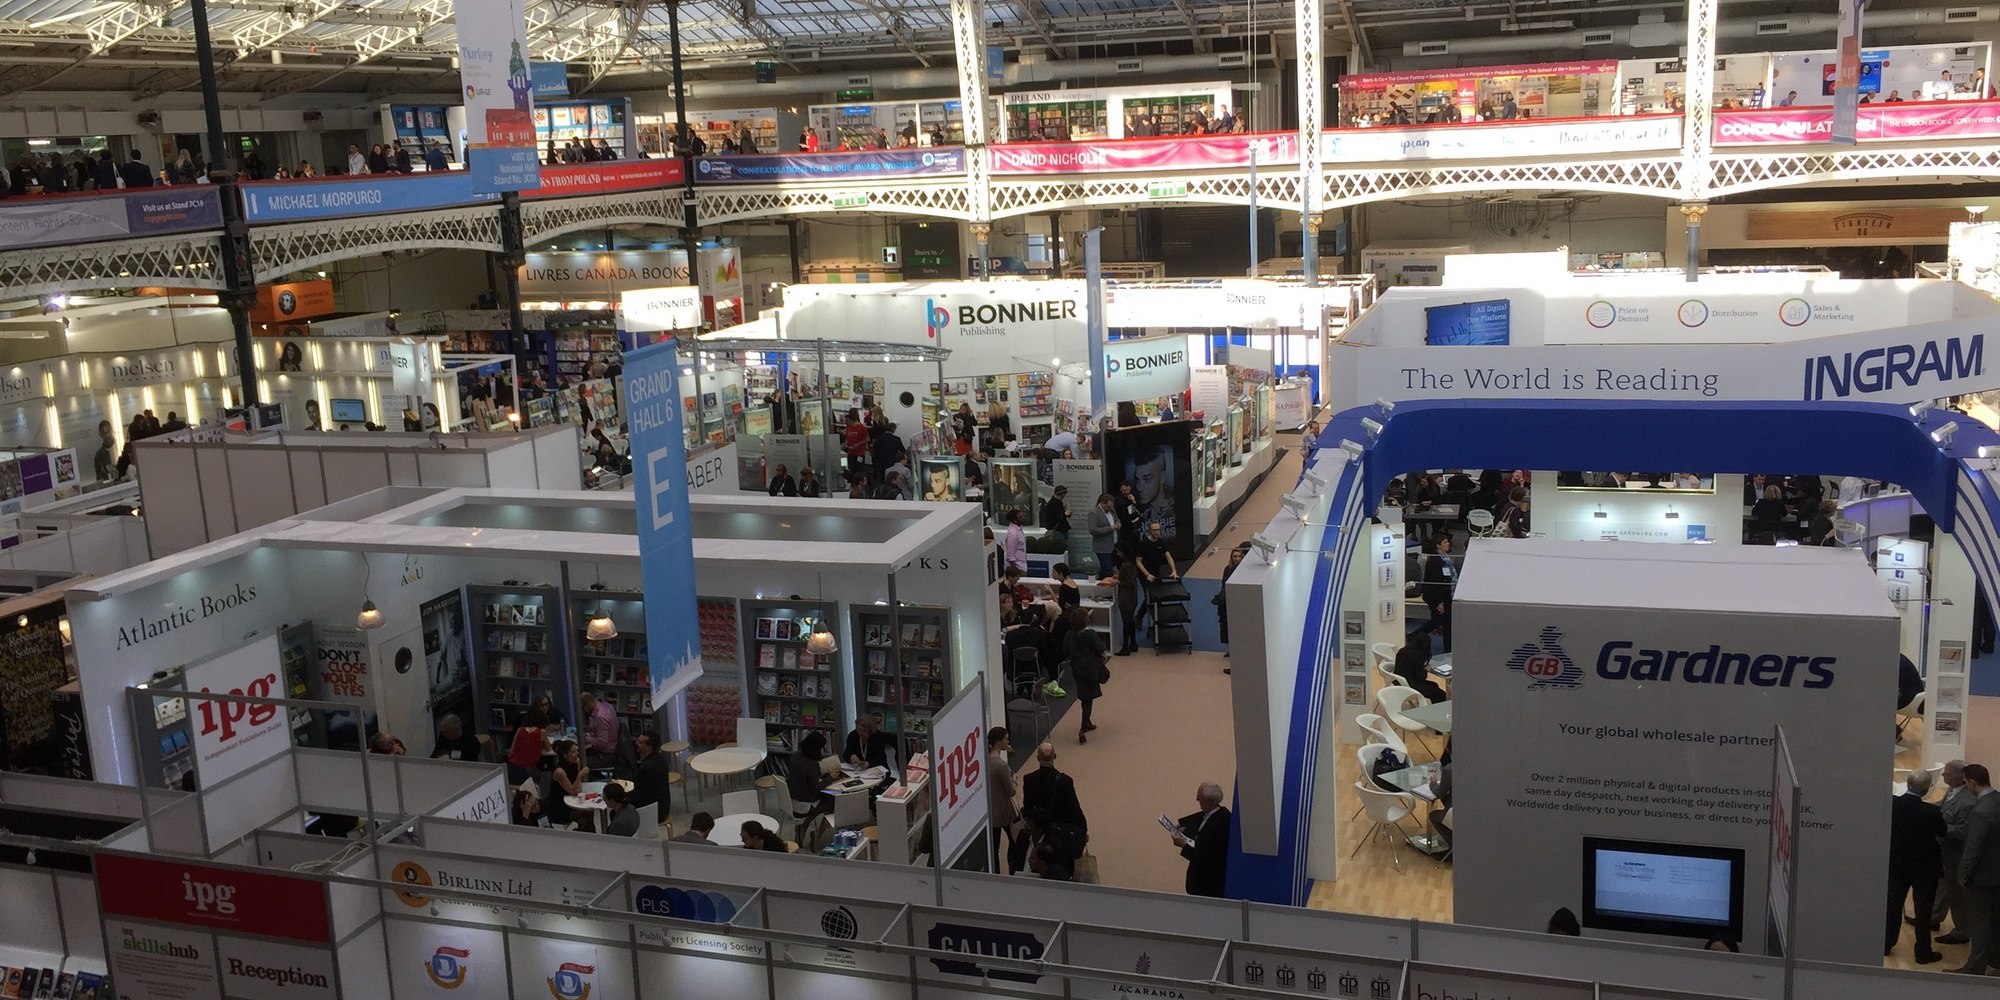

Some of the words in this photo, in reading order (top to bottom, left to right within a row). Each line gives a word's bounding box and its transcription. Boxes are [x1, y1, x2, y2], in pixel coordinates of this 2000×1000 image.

[461, 47, 493, 62] Turkey
[1011, 93, 1051, 102] IRELAND
[1900, 119, 1929, 127] LONDON
[1976, 116, 1997, 124] WEEK
[511, 152, 527, 162] VISIT
[528, 152, 535, 161] US
[1010, 153, 1047, 167] DAVID
[738, 165, 808, 175] CONGRATULATIONS
[820, 164, 834, 173] ALL
[835, 163, 852, 173] OUR
[854, 162, 881, 171] AWARD
[882, 160, 920, 170] WINNERS
[493, 175, 512, 186] Stand
[550, 174, 573, 188] FROM
[573, 173, 601, 185] POLAND
[142, 203, 157, 213] Visit
[172, 201, 189, 211] Stand
[268, 194, 320, 211] MICHAEL
[321, 190, 382, 207] MORPURGO
[34, 215, 65, 230] Rights
[68, 213, 111, 227] Solutions
[1834, 220, 1893, 231] EIGHTEEN
[1857, 228, 1868, 236] 86
[526, 268, 571, 283] LIVRES
[575, 268, 638, 281] CANADA
[641, 266, 691, 281] BOOKS
[959, 299, 1077, 326] BONNIER
[1476, 305, 1486, 313] All
[1486, 303, 1508, 314] Digital
[1617, 307, 1636, 315] Print
[1711, 309, 1758, 318] Distribution
[1813, 304, 1834, 313] Sales
[1834, 304, 1841, 312] &
[1813, 312, 1855, 322] Marketing
[1480, 313, 1508, 323] Platform
[1617, 315, 1650, 323] Demand
[959, 325, 1007, 337] Publishing
[111, 358, 176, 378] nielsen
[1125, 350, 1184, 371] BONNIER
[1803, 333, 1985, 401] INGRAM
[1125, 369, 1154, 378] Publishing
[1400, 367, 1455, 391] The
[1463, 367, 1552, 391] World
[1563, 367, 1585, 391] is
[1595, 366, 1720, 397] Reading
[0, 374, 32, 393] lsen
[629, 369, 673, 405] GRAND
[633, 405, 665, 435] HALL
[664, 398, 674, 423] 6
[686, 456, 724, 490] ABER
[1066, 463, 1096, 472] BONNIER
[647, 446, 674, 532] E
[401, 566, 425, 587] A&U
[116, 606, 197, 651] Atlantic
[200, 583, 257, 619] Books
[421, 605, 433, 617] JIM
[318, 648, 360, 663] DON'T
[327, 661, 368, 675] CLOSE
[1527, 657, 1561, 678] GB
[1595, 640, 1837, 690] Gardners
[320, 672, 358, 686] YOUR
[333, 684, 366, 697] EYES
[198, 673, 277, 743] ipg
[1559, 723, 1592, 737] Your
[1595, 724, 1639, 740] global
[1642, 728, 1715, 744] wholesale
[1719, 734, 1775, 748] partner
[937, 726, 980, 810] ipg
[1531, 772, 1555, 783] Over
[1557, 774, 1565, 783] 2
[1566, 775, 1601, 787] million
[1603, 777, 1646, 791] physical
[1647, 780, 1656, 790] &
[1658, 780, 1691, 794] digital
[1692, 783, 1741, 798] products
[1524, 787, 1551, 797] same
[1553, 786, 1572, 799] day
[1574, 788, 1624, 803] despatch,
[1626, 792, 1649, 803] next
[1651, 793, 1694, 808] working
[1695, 796, 1715, 810] day
[1717, 798, 1761, 814] delivery
[1507, 798, 1560, 811] Worldwide
[1562, 802, 1603, 816] delivery
[1604, 804, 1616, 815] to
[1617, 807, 1642, 819] your
[1644, 806, 1693, 821] business,
[1694, 812, 1706, 822] or
[1708, 811, 1739, 824] direct
[1740, 814, 1753, 825] to
[1754, 816, 1773, 828] you
[1800, 820, 1834, 831] tomer
[438, 870, 504, 893] BIRLINN
[507, 878, 533, 897] Ltd
[182, 872, 237, 915] ipg
[641, 898, 671, 915] PLS
[121, 926, 134, 937] ipg
[122, 936, 199, 961] skillshub
[638, 930, 685, 946] Publiers
[686, 935, 729, 952] Licensing
[729, 941, 763, 955] Society
[228, 957, 329, 989] Reception
[1111, 984, 1186, 1000] JACARANDA
